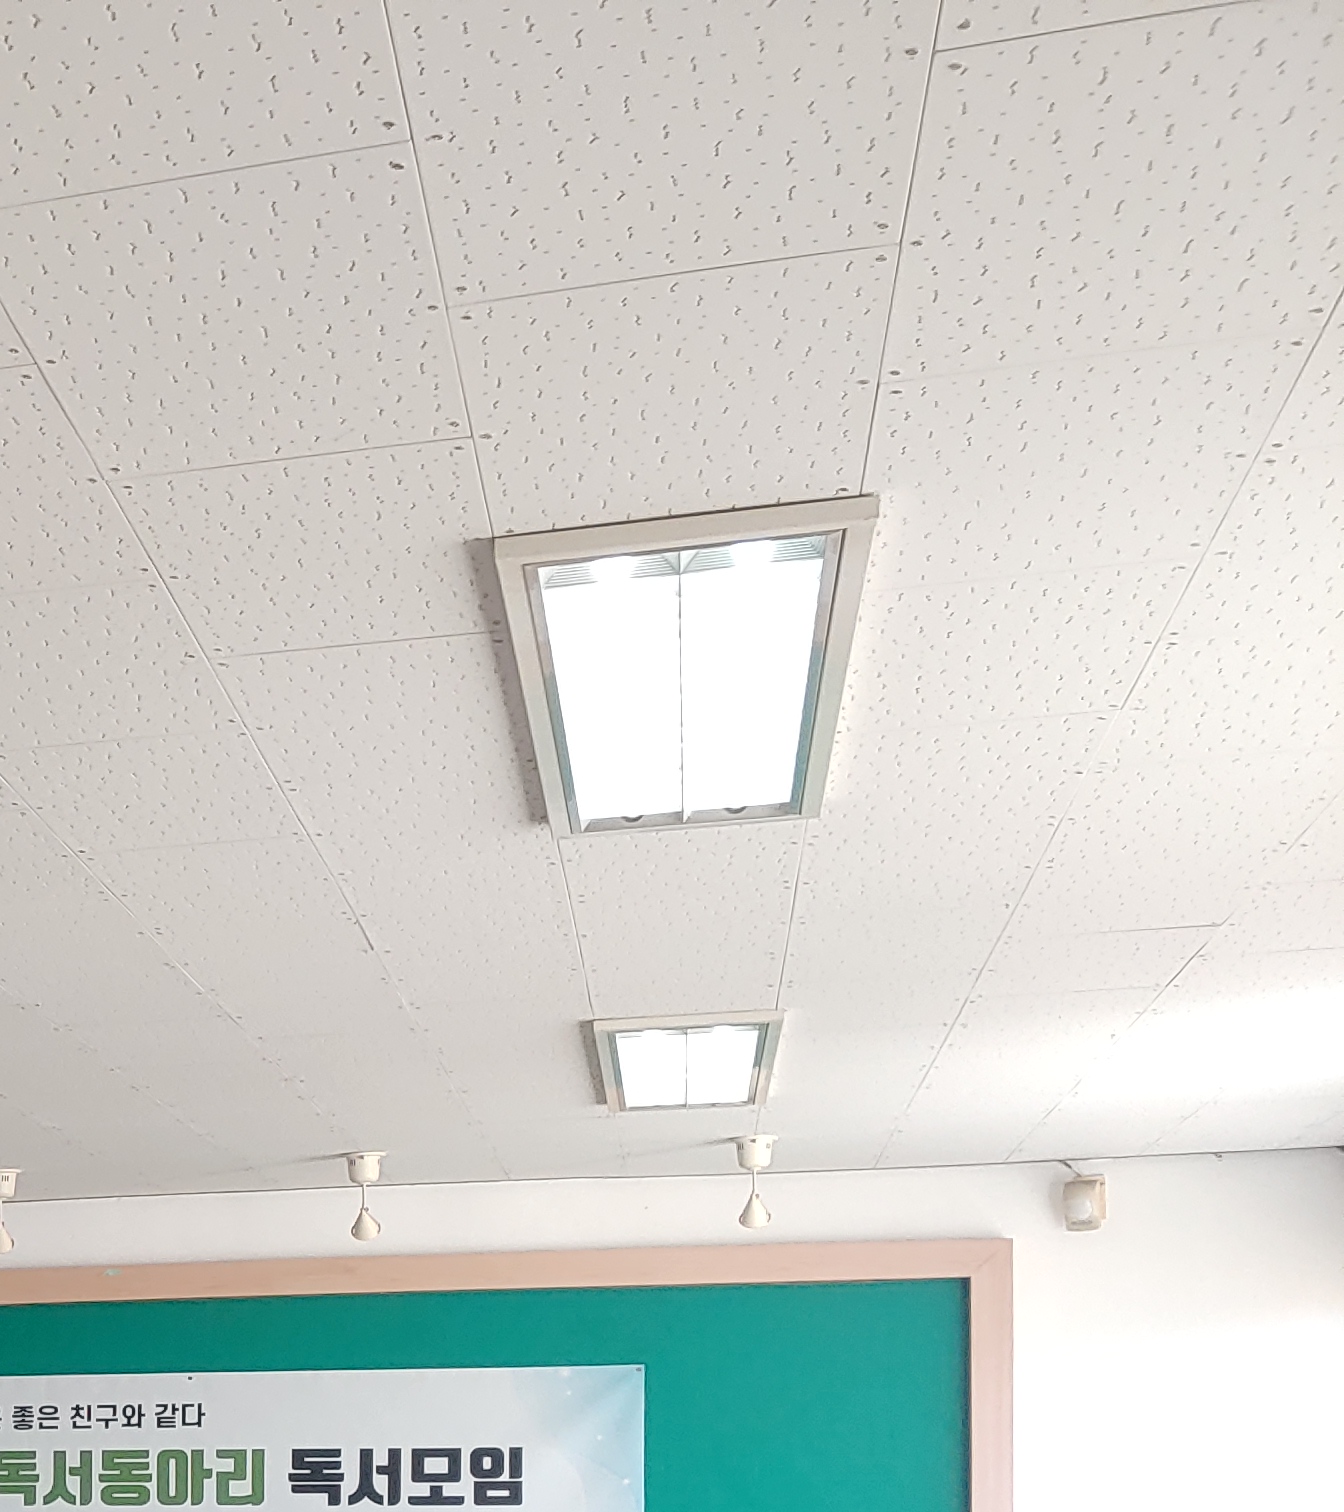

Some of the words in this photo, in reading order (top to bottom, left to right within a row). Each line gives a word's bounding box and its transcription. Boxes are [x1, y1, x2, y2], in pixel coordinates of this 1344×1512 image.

[11, 1404, 60, 1431] 좋은
[70, 1403, 146, 1430] 친구와
[154, 1402, 206, 1429] 같다
[288, 1447, 523, 1507] 독서모임
